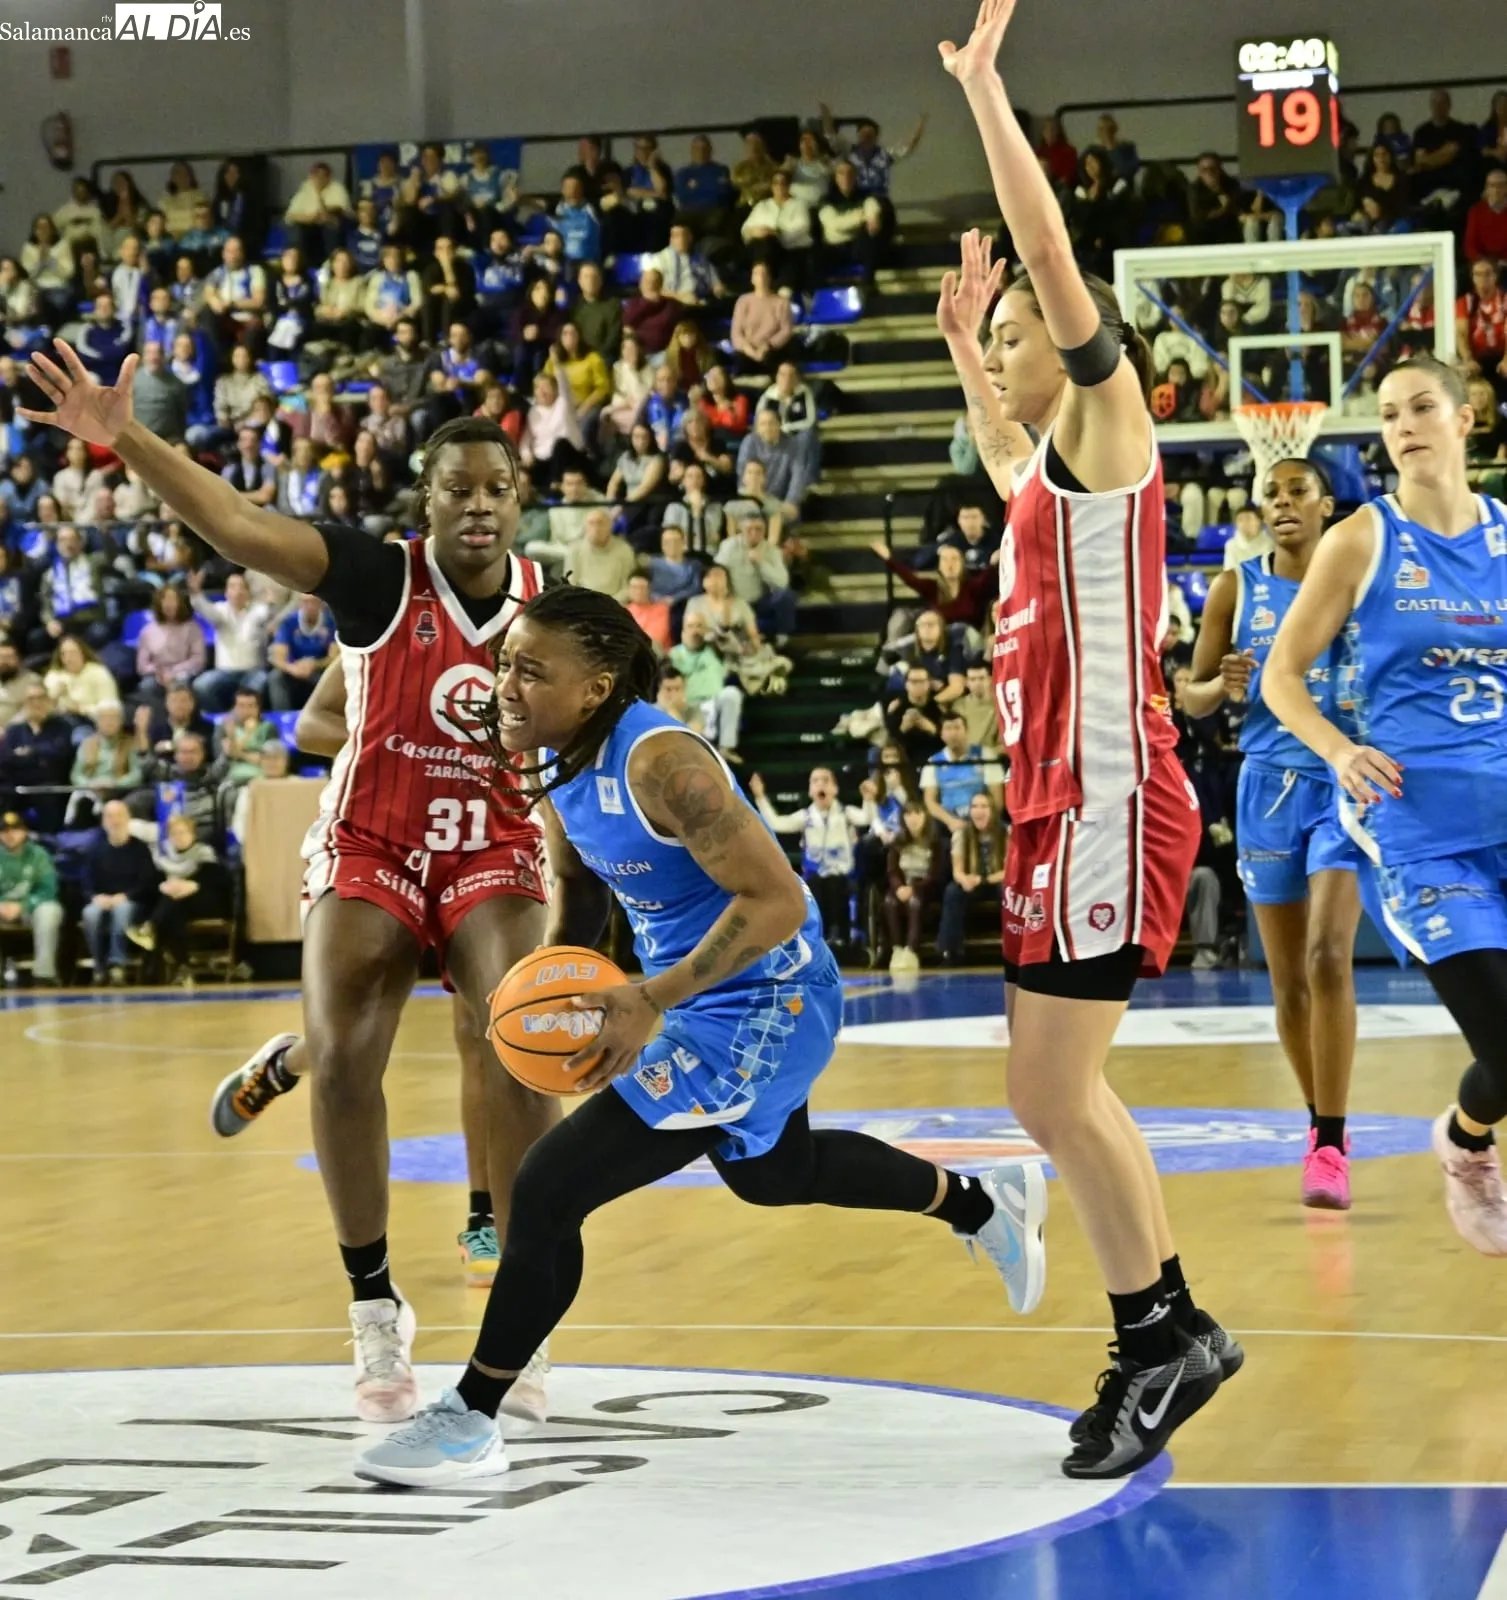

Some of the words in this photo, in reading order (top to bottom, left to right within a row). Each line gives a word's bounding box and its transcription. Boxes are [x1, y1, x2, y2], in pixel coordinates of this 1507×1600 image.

[1239, 38, 1326, 73] 02:40
[1247, 89, 1321, 148] 19
[1395, 599, 1474, 612] CASTILLA
[996, 678, 1023, 747] 13
[1448, 675, 1504, 722] 23
[424, 798, 491, 851] 31
[456, 869, 515, 888] Zaragoza
[610, 859, 653, 876] LEÓN
[457, 877, 516, 897] DEPORTE
